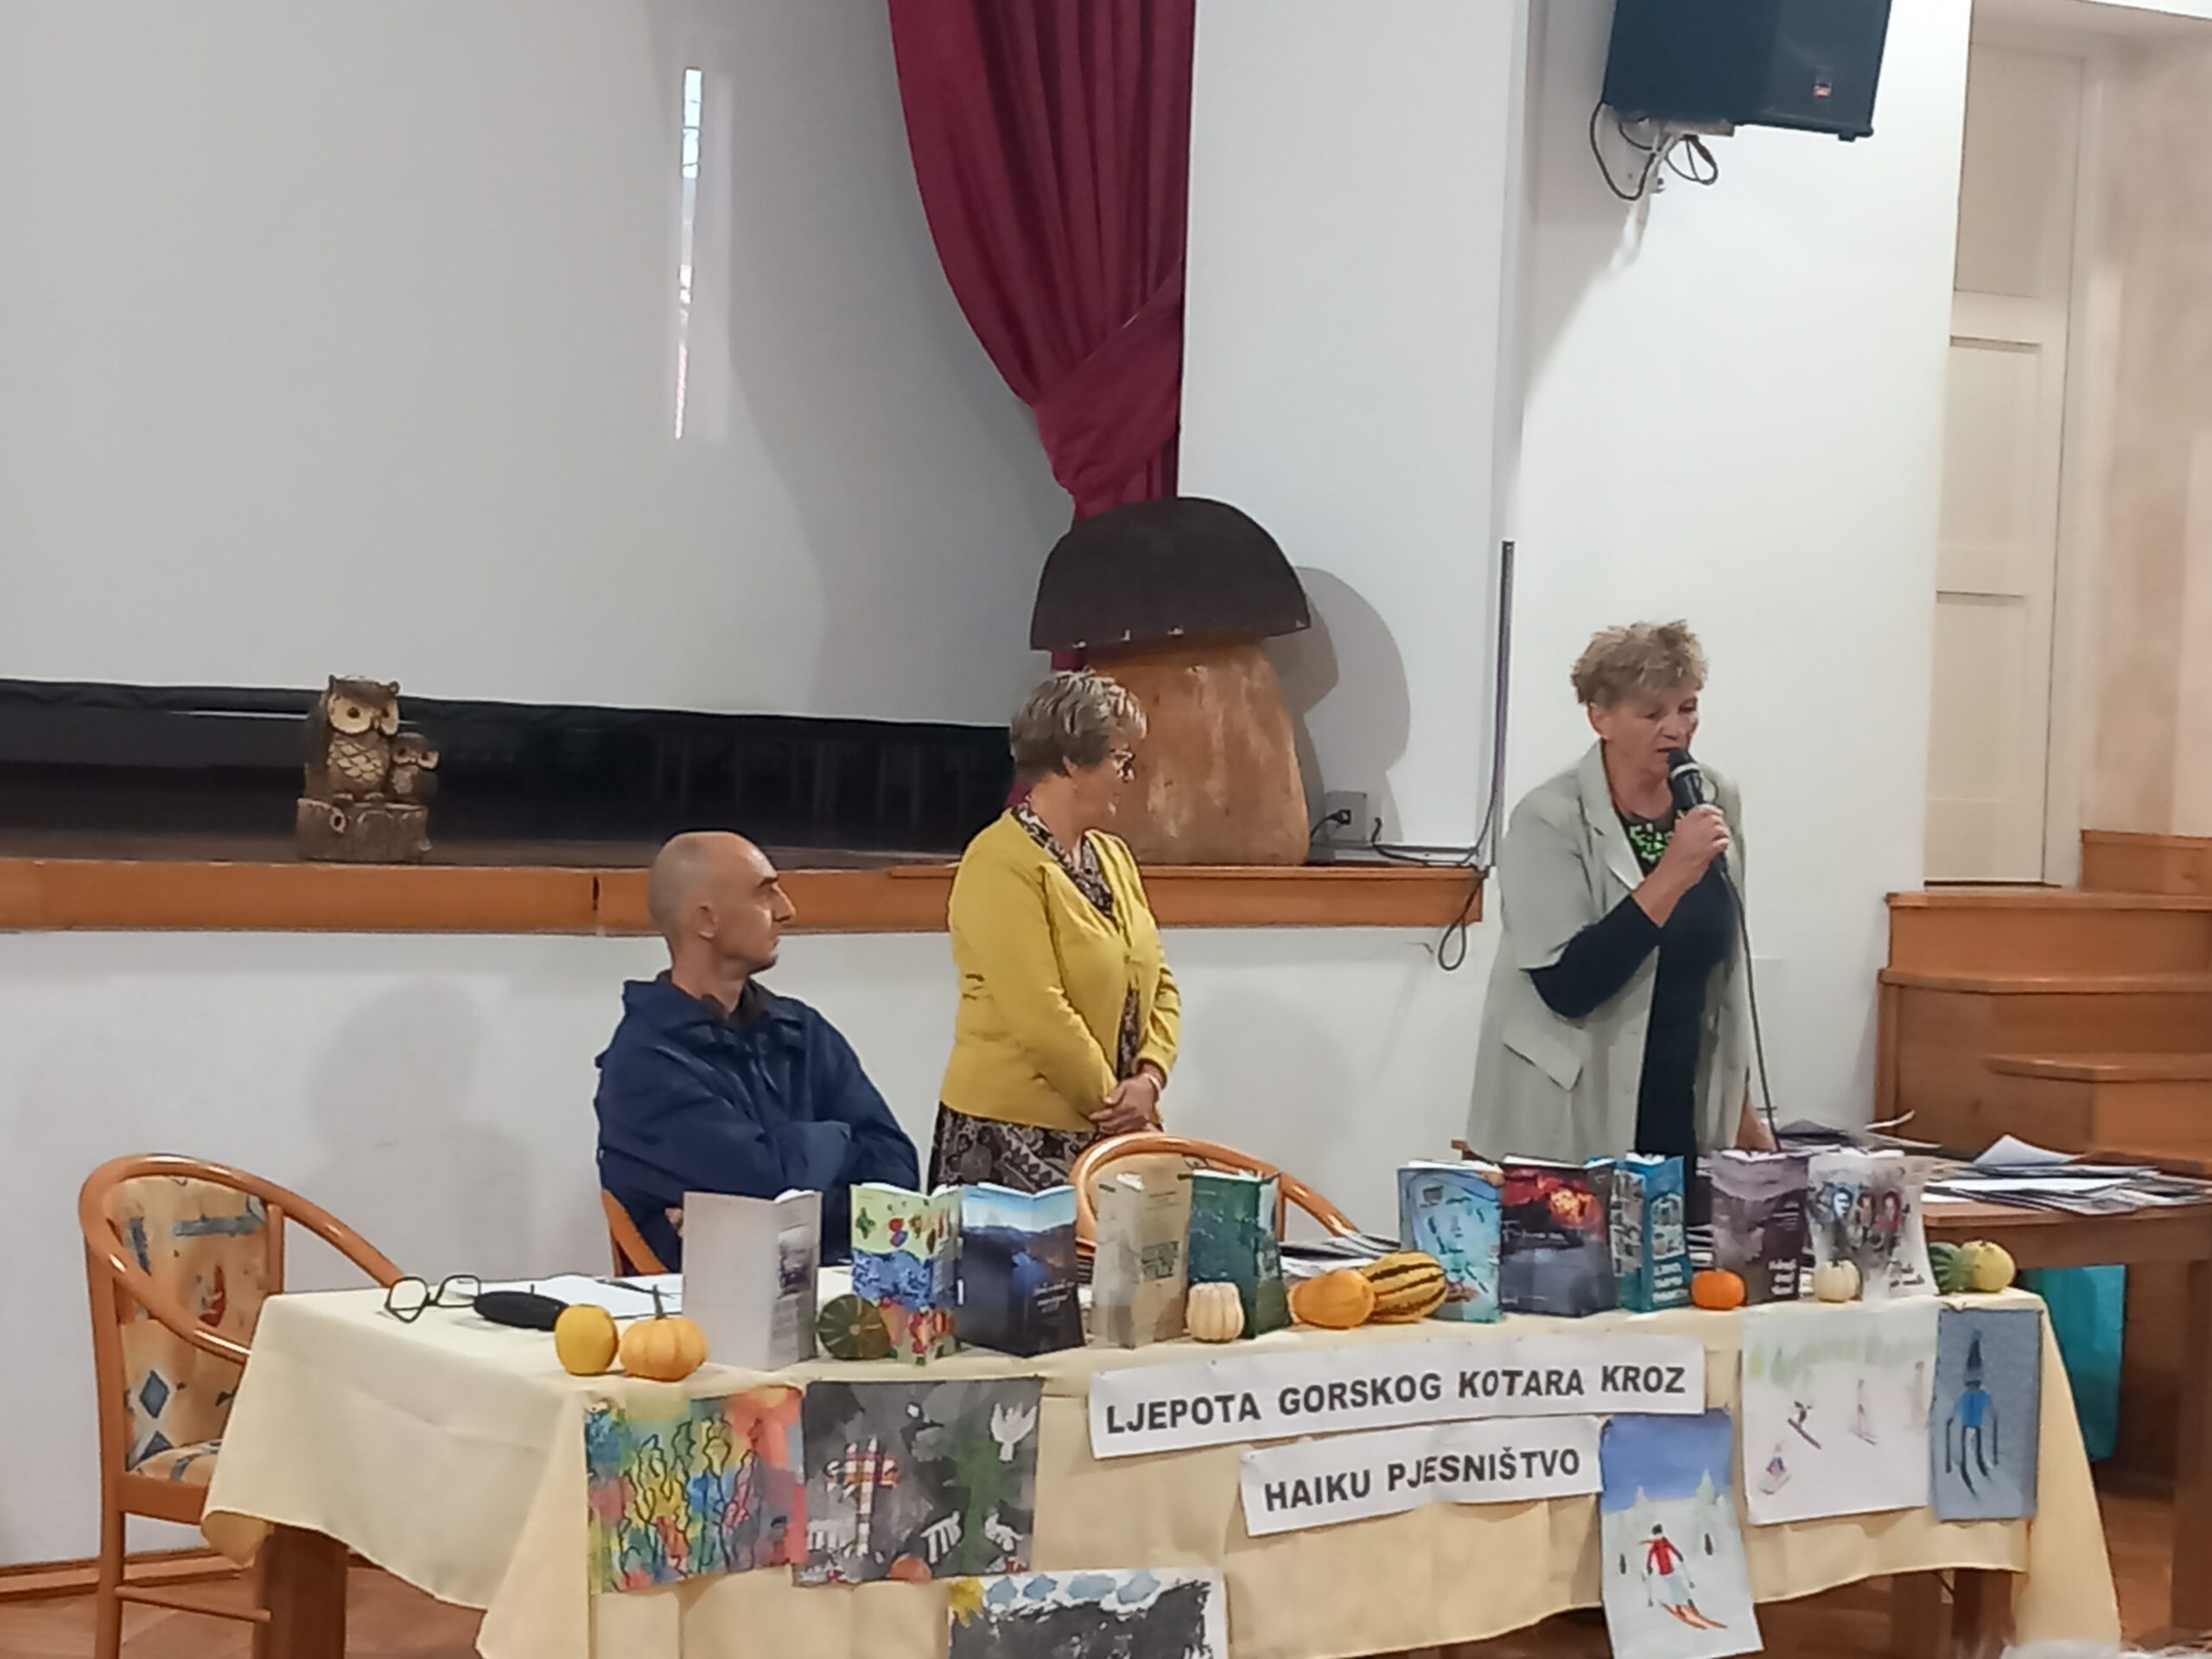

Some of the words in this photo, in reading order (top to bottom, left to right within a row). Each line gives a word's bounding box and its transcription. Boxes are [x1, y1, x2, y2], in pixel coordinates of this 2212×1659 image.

[1107, 1393, 1261, 1433] LJEPOTA
[1278, 1373, 1441, 1415] GORSKOG
[1459, 1369, 1585, 1398] KOTARA
[1601, 1365, 1685, 1394] KROZ
[1264, 1469, 1370, 1511] HAIKU
[1388, 1446, 1580, 1491] PJESNIŠTVO
